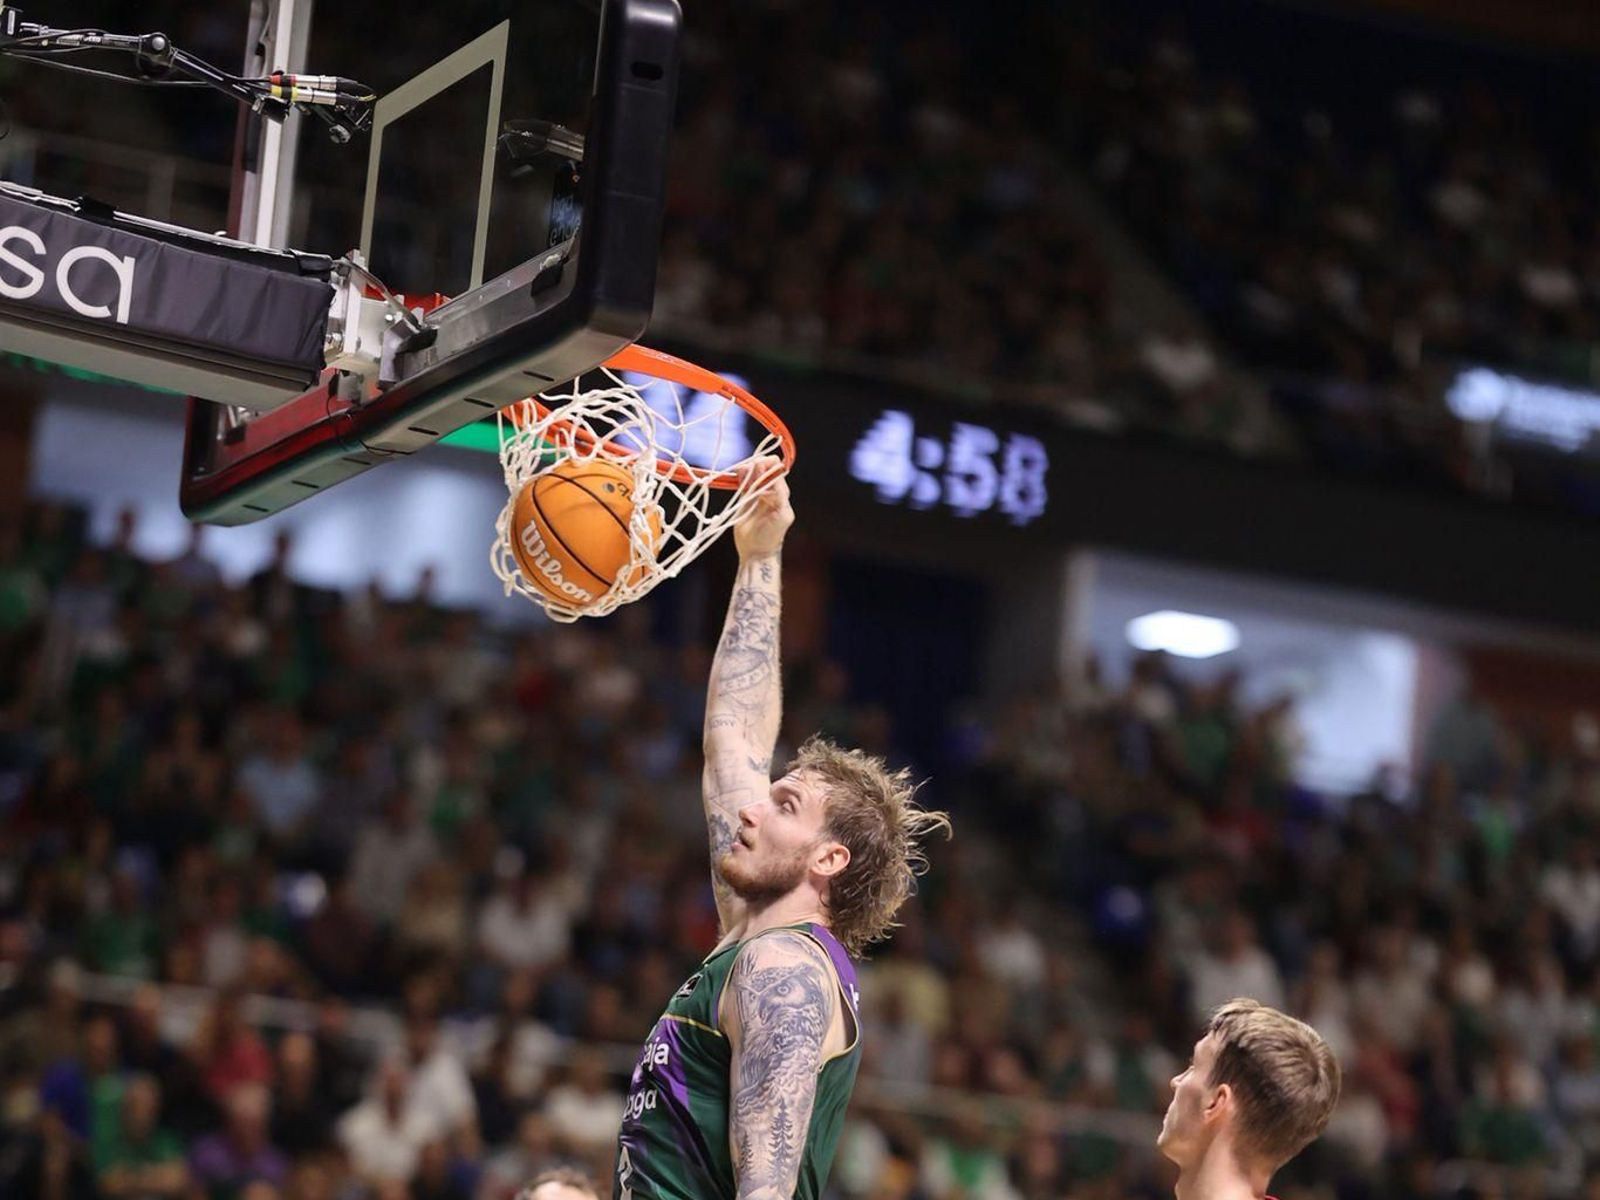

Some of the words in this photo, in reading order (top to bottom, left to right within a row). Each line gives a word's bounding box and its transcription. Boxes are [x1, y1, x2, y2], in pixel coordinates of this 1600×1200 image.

[0, 225, 136, 324] sa
[850, 408, 1048, 526] 4:58
[521, 520, 594, 602] Wilson
